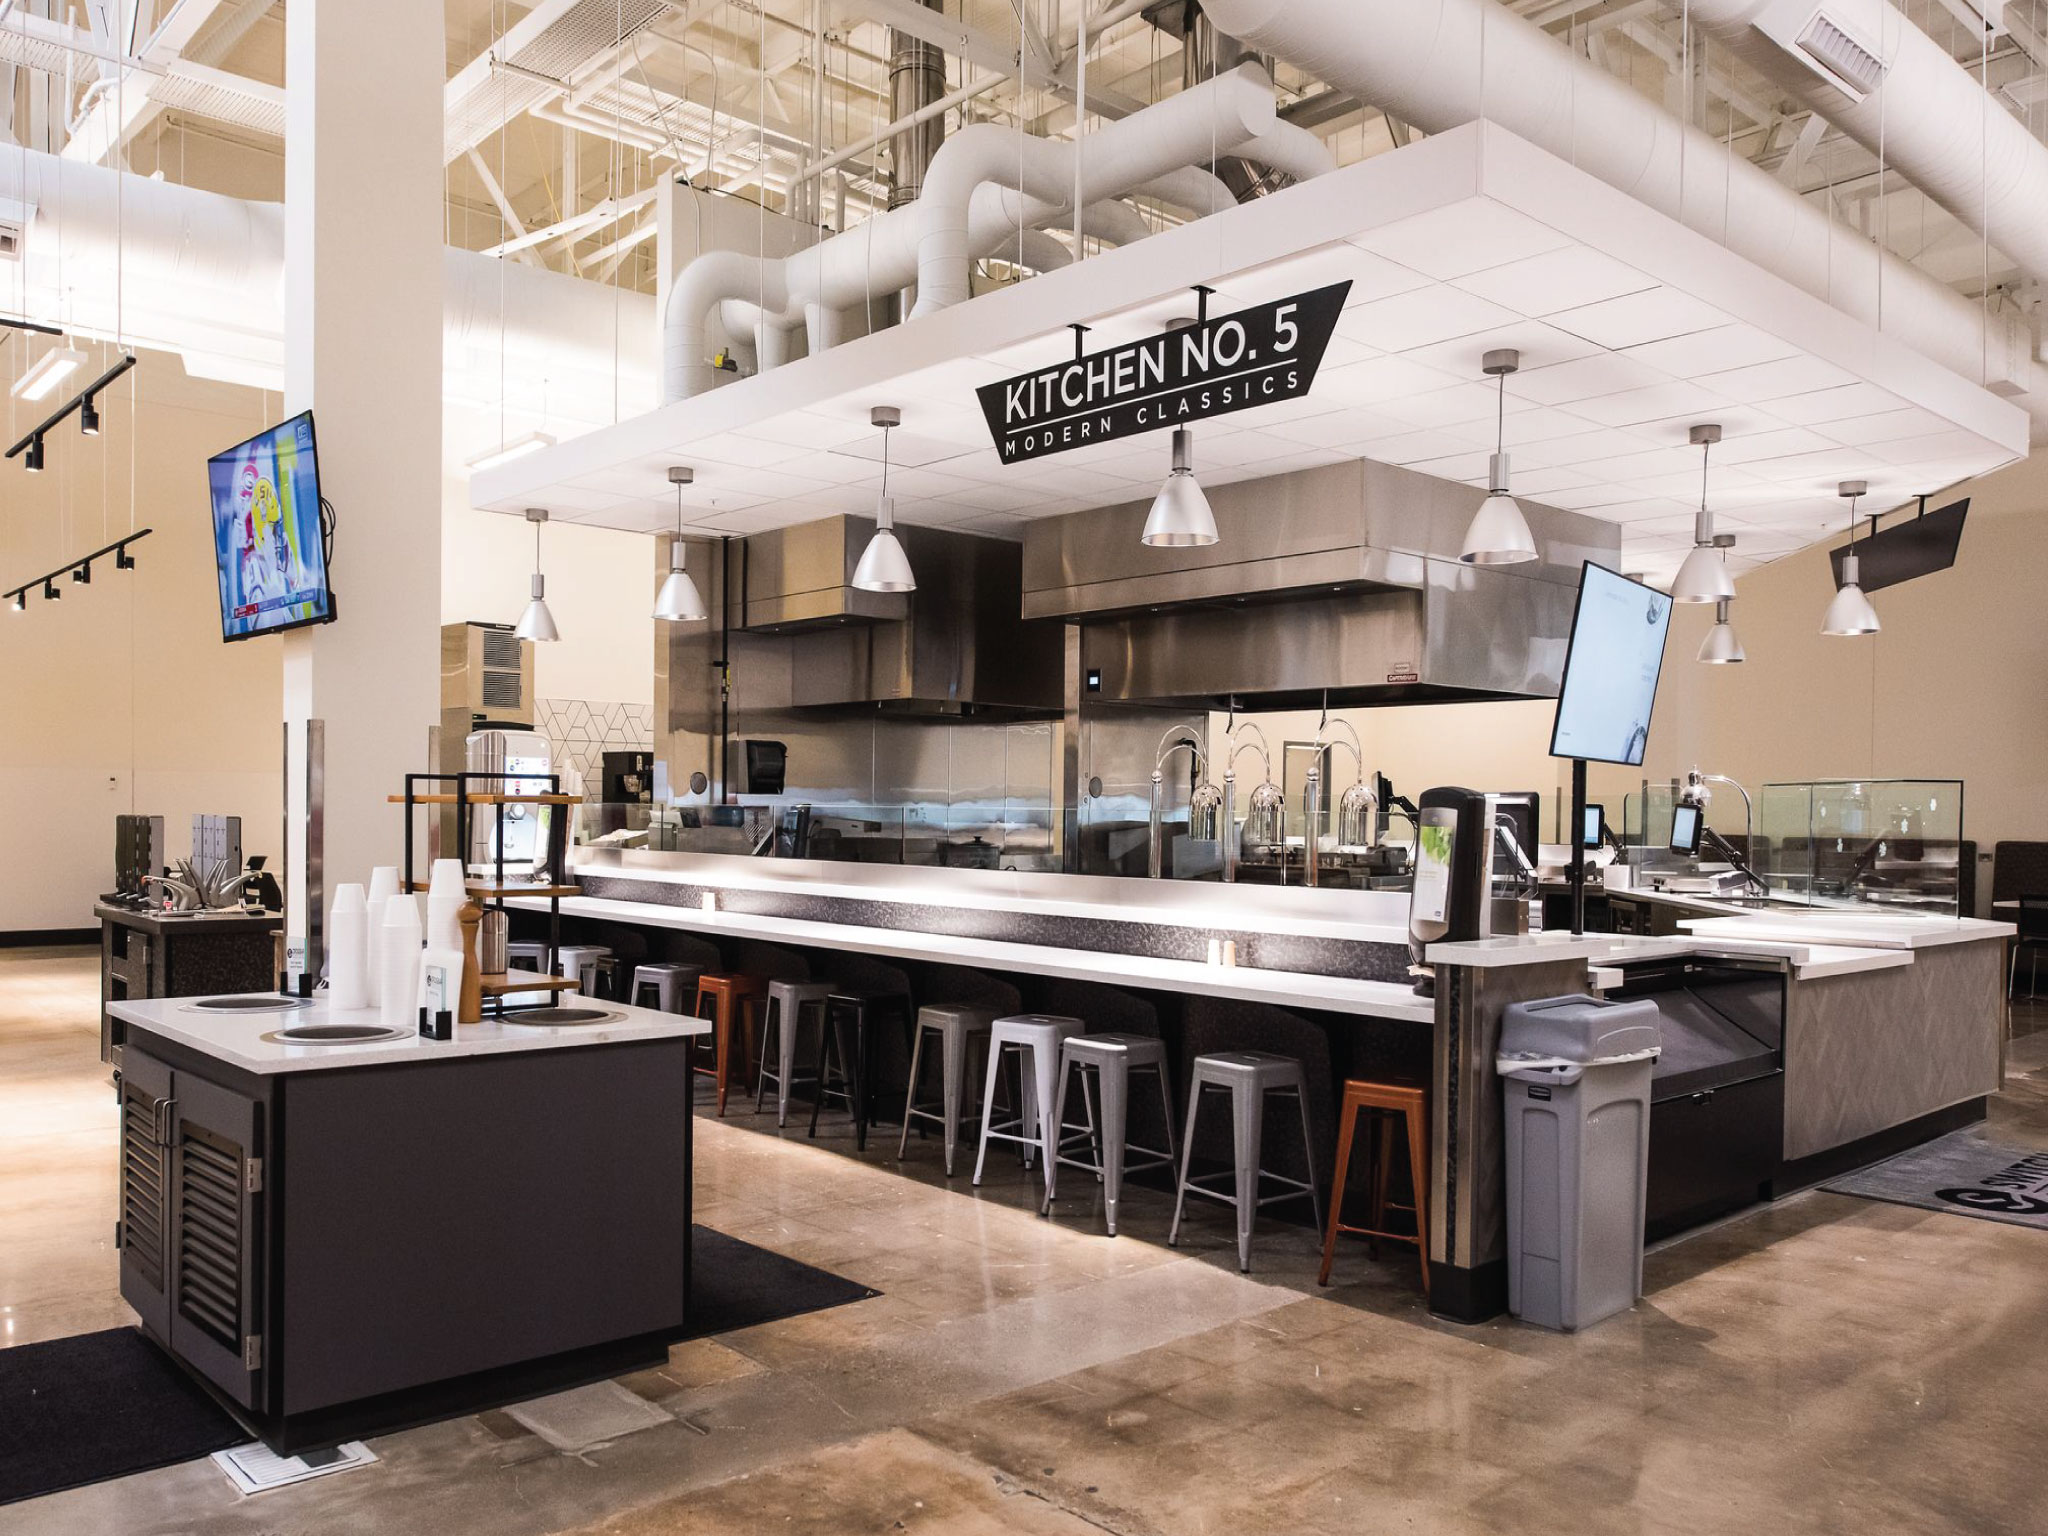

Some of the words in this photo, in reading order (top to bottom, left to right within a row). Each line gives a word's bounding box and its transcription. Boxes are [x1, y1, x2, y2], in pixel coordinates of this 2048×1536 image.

[1005, 416, 1112, 456] MODERN
[1136, 371, 1298, 425] CLASSICS
[1006, 340, 1165, 424] KITCHEN
[1182, 320, 1257, 377] NO.
[1273, 303, 1298, 353] 5
